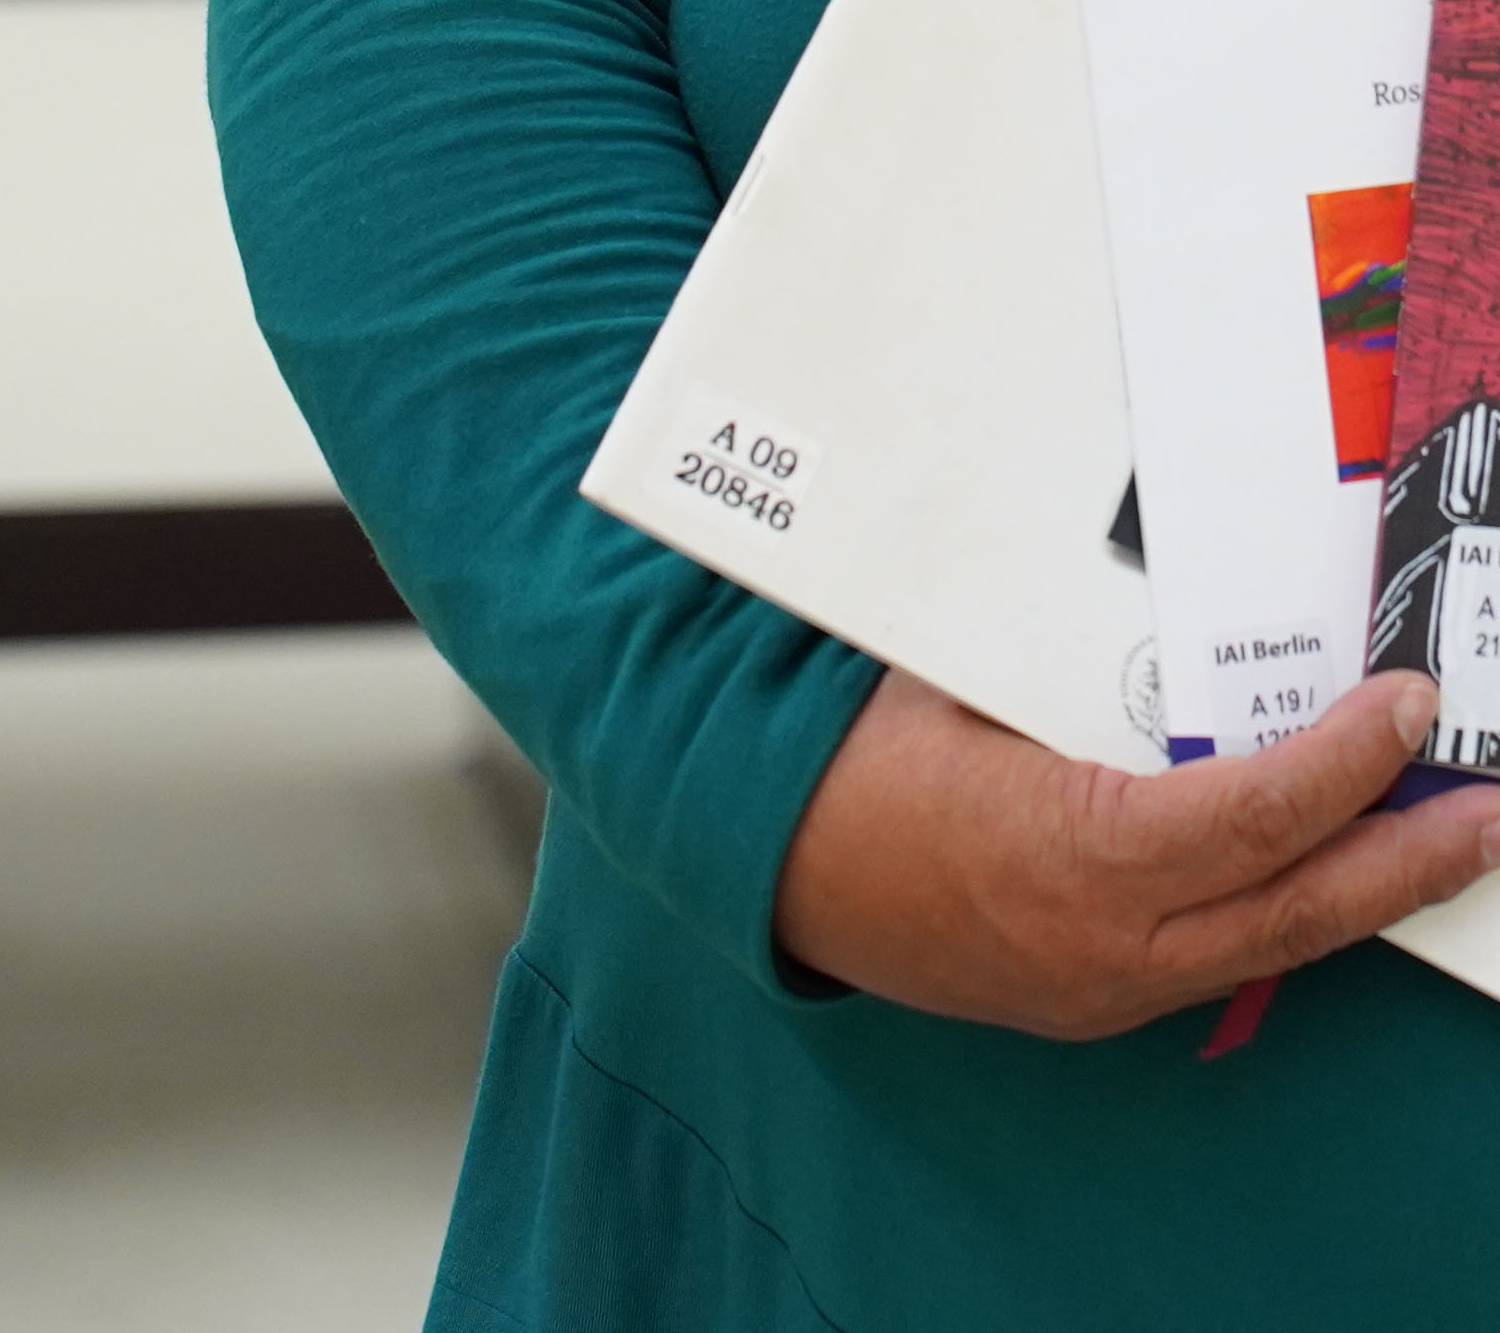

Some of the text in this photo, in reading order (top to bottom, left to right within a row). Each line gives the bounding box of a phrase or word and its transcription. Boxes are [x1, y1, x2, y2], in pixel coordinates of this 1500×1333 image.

[711, 420, 798, 479] A 09
[675, 453, 794, 530] 20846
[1460, 545, 1491, 565] IAI
[1477, 596, 1495, 620] A
[1214, 633, 1321, 665] IAI Berlin
[1251, 694, 1268, 718] A
[1276, 689, 1300, 714] 19
